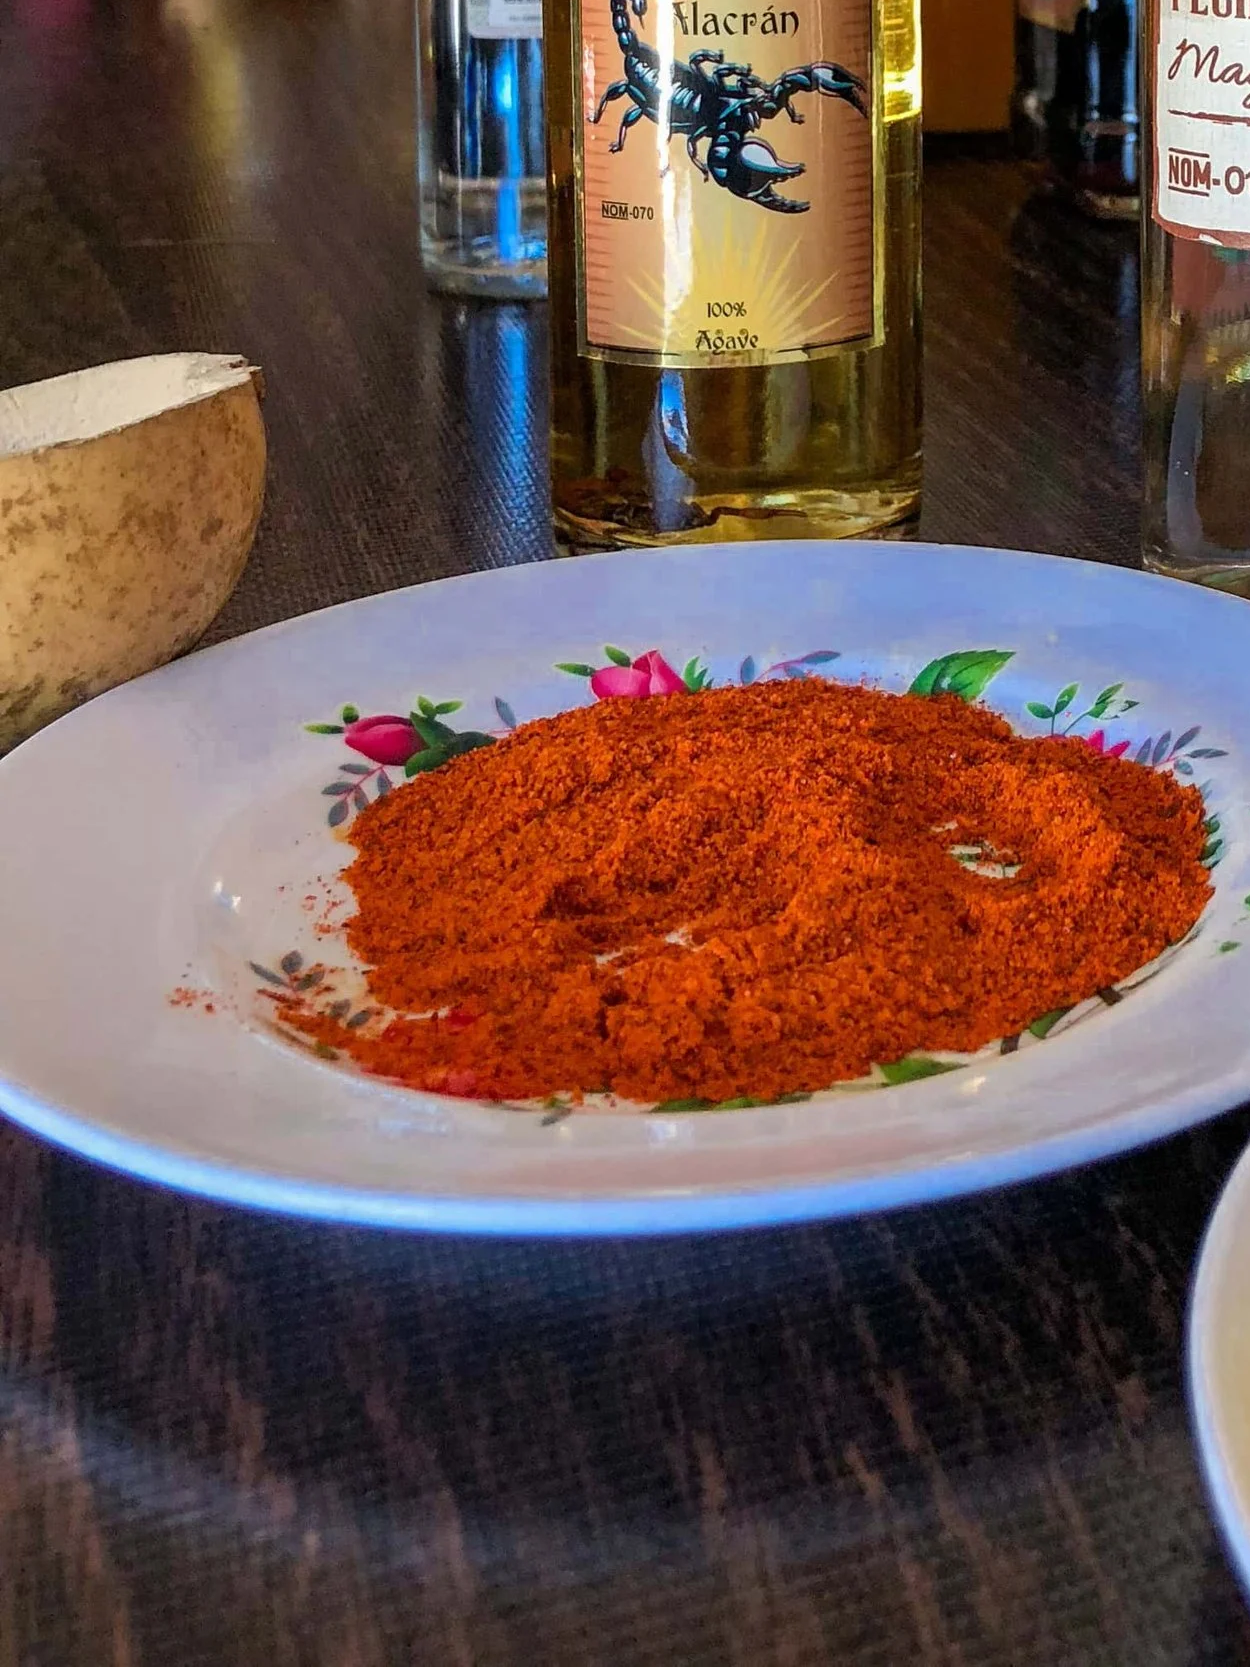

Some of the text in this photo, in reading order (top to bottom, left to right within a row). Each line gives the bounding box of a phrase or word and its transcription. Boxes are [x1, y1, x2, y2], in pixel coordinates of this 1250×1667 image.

[601, 200, 655, 221] NOM-070
[706, 301, 748, 319] 100%
[695, 328, 759, 355] Agave
